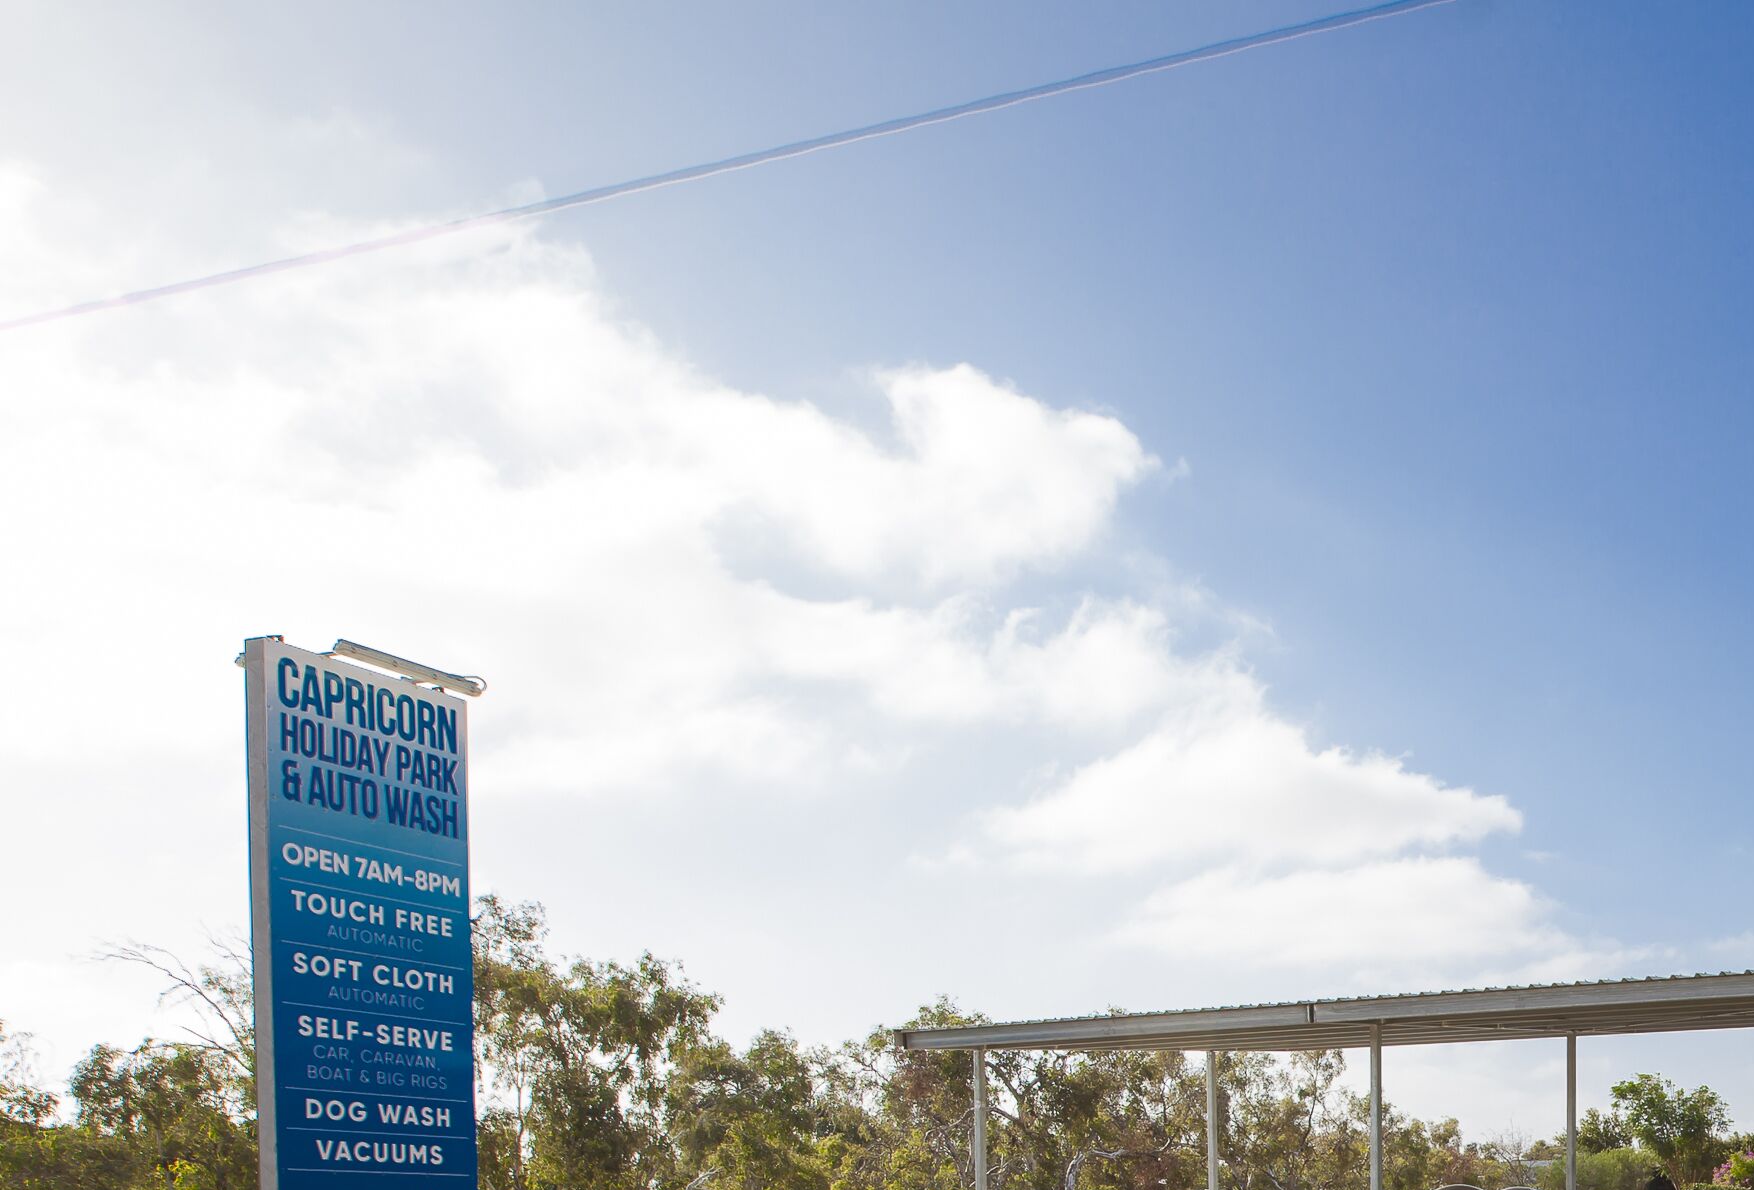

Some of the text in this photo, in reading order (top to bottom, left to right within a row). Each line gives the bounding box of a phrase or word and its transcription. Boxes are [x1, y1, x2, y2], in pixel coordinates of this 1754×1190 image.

[277, 657, 457, 754] CAPRICORN
[281, 712, 460, 796] HOLIDAY PARK
[282, 759, 459, 840] & AUTO WASH
[282, 842, 461, 898] OPEN 7AM-8PM
[291, 889, 453, 938] TOUCH FREE
[327, 924, 424, 953] AUTOMATIC
[292, 952, 454, 995] SOFT CLOTH
[328, 985, 425, 1010] AUTOMATIC
[298, 1015, 453, 1052] SELF-SERVE
[307, 1064, 448, 1090] BOAT & BIG RIGS
[305, 1098, 451, 1128] DOG WASH
[316, 1139, 444, 1165] VACUUMS
